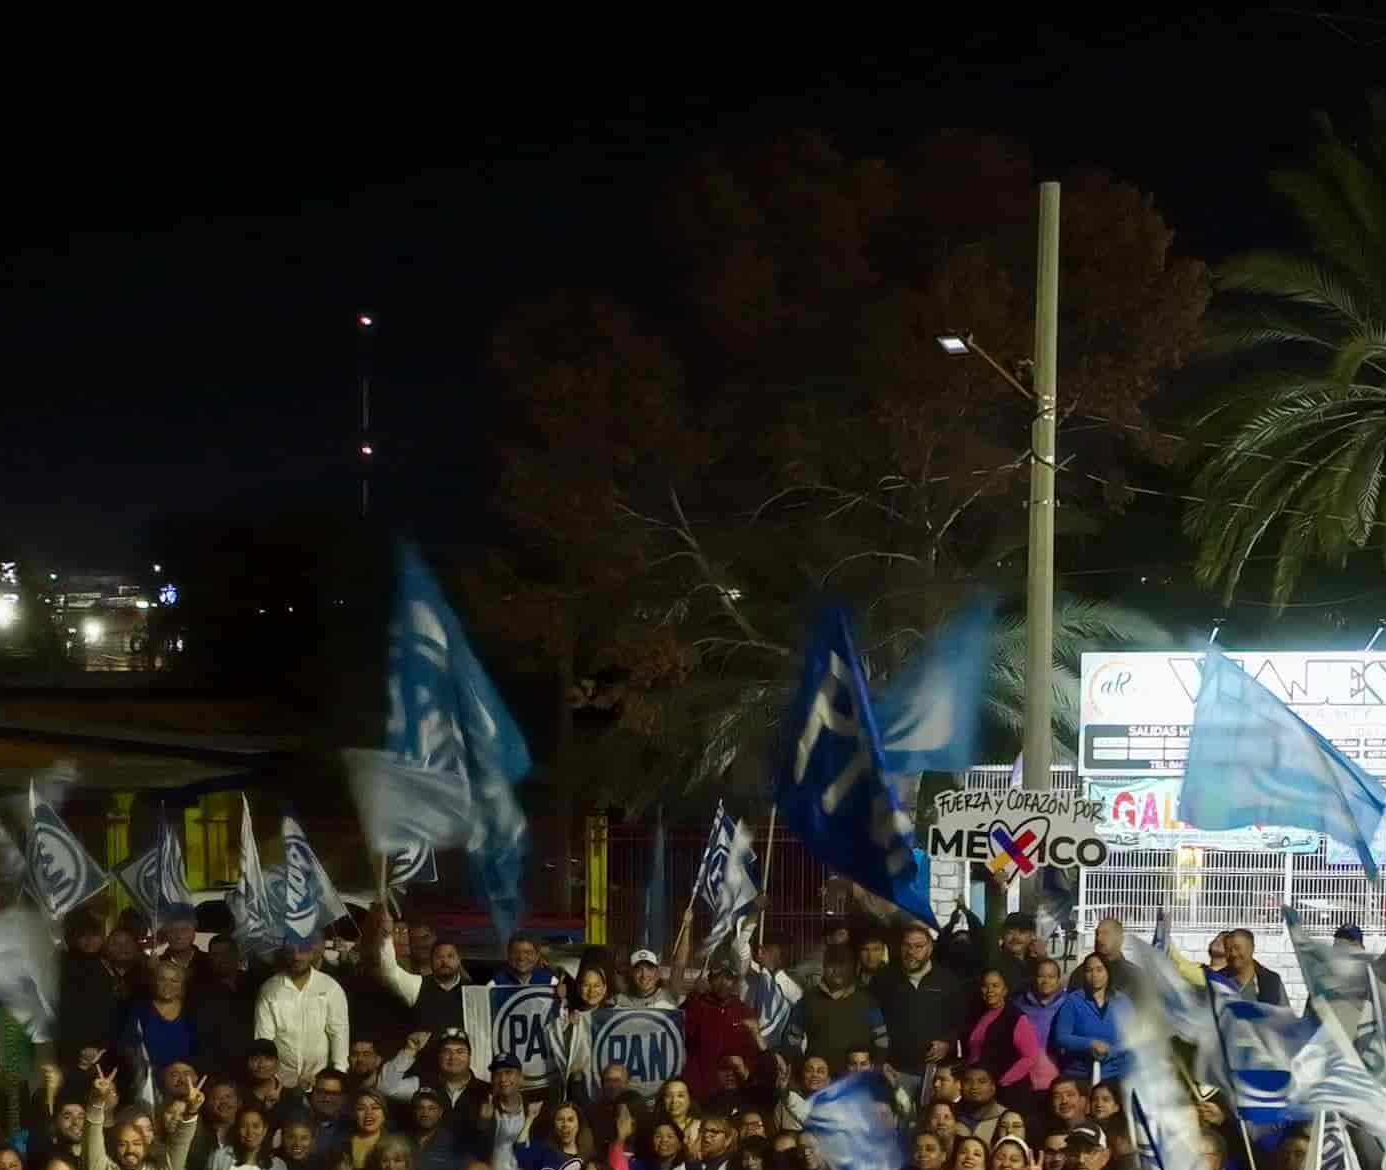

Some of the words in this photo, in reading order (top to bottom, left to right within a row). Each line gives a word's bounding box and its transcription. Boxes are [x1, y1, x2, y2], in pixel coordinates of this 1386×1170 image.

[938, 792, 991, 817] FUERZA
[1007, 788, 1070, 817] CORAZÓN
[1072, 799, 1106, 823] POR
[930, 820, 1108, 876] MÉXICO
[508, 1013, 549, 1062] PA
[608, 1031, 667, 1083] PAN
